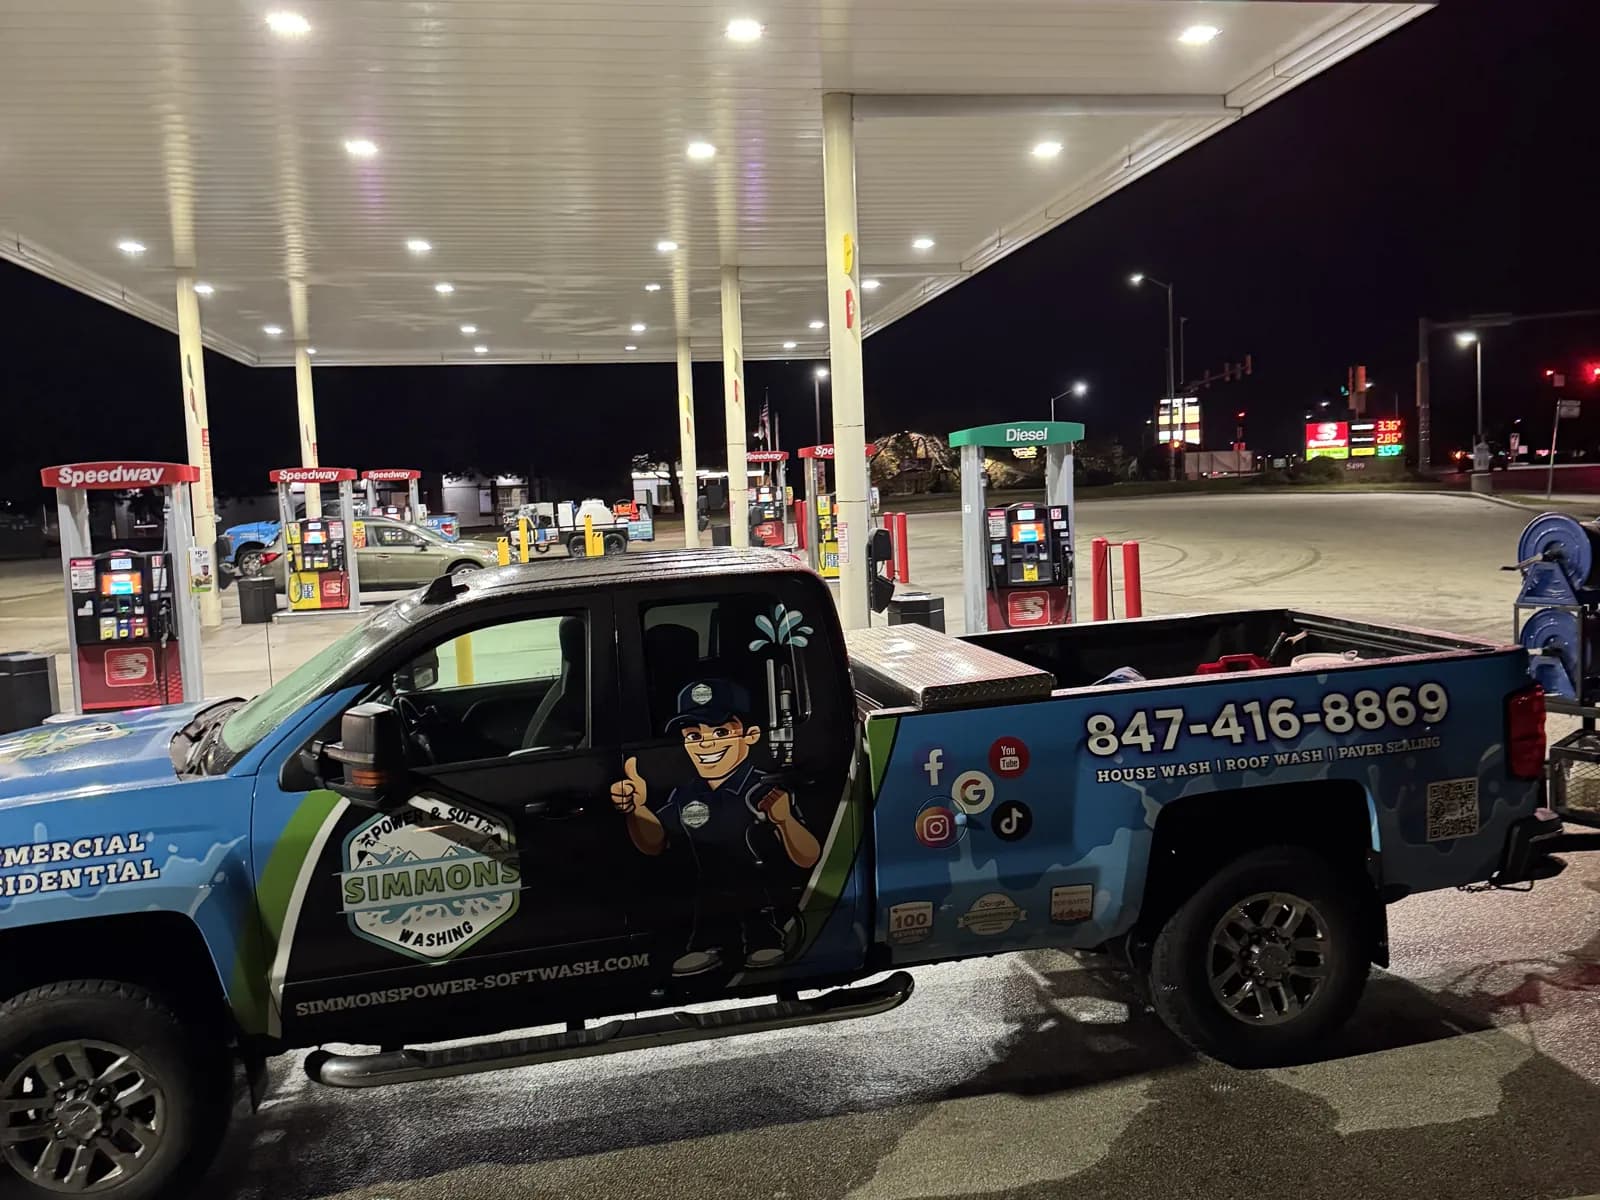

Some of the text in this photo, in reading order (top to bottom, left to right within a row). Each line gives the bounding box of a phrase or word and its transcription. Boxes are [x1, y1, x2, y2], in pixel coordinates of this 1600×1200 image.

[1006, 427, 1048, 442] Diesel
[58, 465, 164, 486] Speedway
[279, 469, 339, 481] Speedway
[368, 470, 410, 480] Speedway
[1087, 683, 1449, 755] 847-416-8869
[1001, 745, 1015, 755] You
[1097, 766, 1156, 782] HOUSE
[1161, 761, 1210, 778] WASH
[1226, 756, 1268, 770] ROOF
[1274, 749, 1323, 767] WASH
[1340, 741, 1385, 758] PAVER
[1386, 736, 1440, 752] SEALING
[1002, 758, 1018, 768] Tube
[431, 807, 441, 821] &
[447, 808, 487, 828] SOFT
[0, 833, 145, 867] MERCIAL
[344, 861, 520, 903] SIMMONS
[895, 912, 927, 928] 100
[399, 921, 473, 946] WASHING
[296, 952, 650, 1016] SIMMONSPOWER-SOFTWASH.COM
